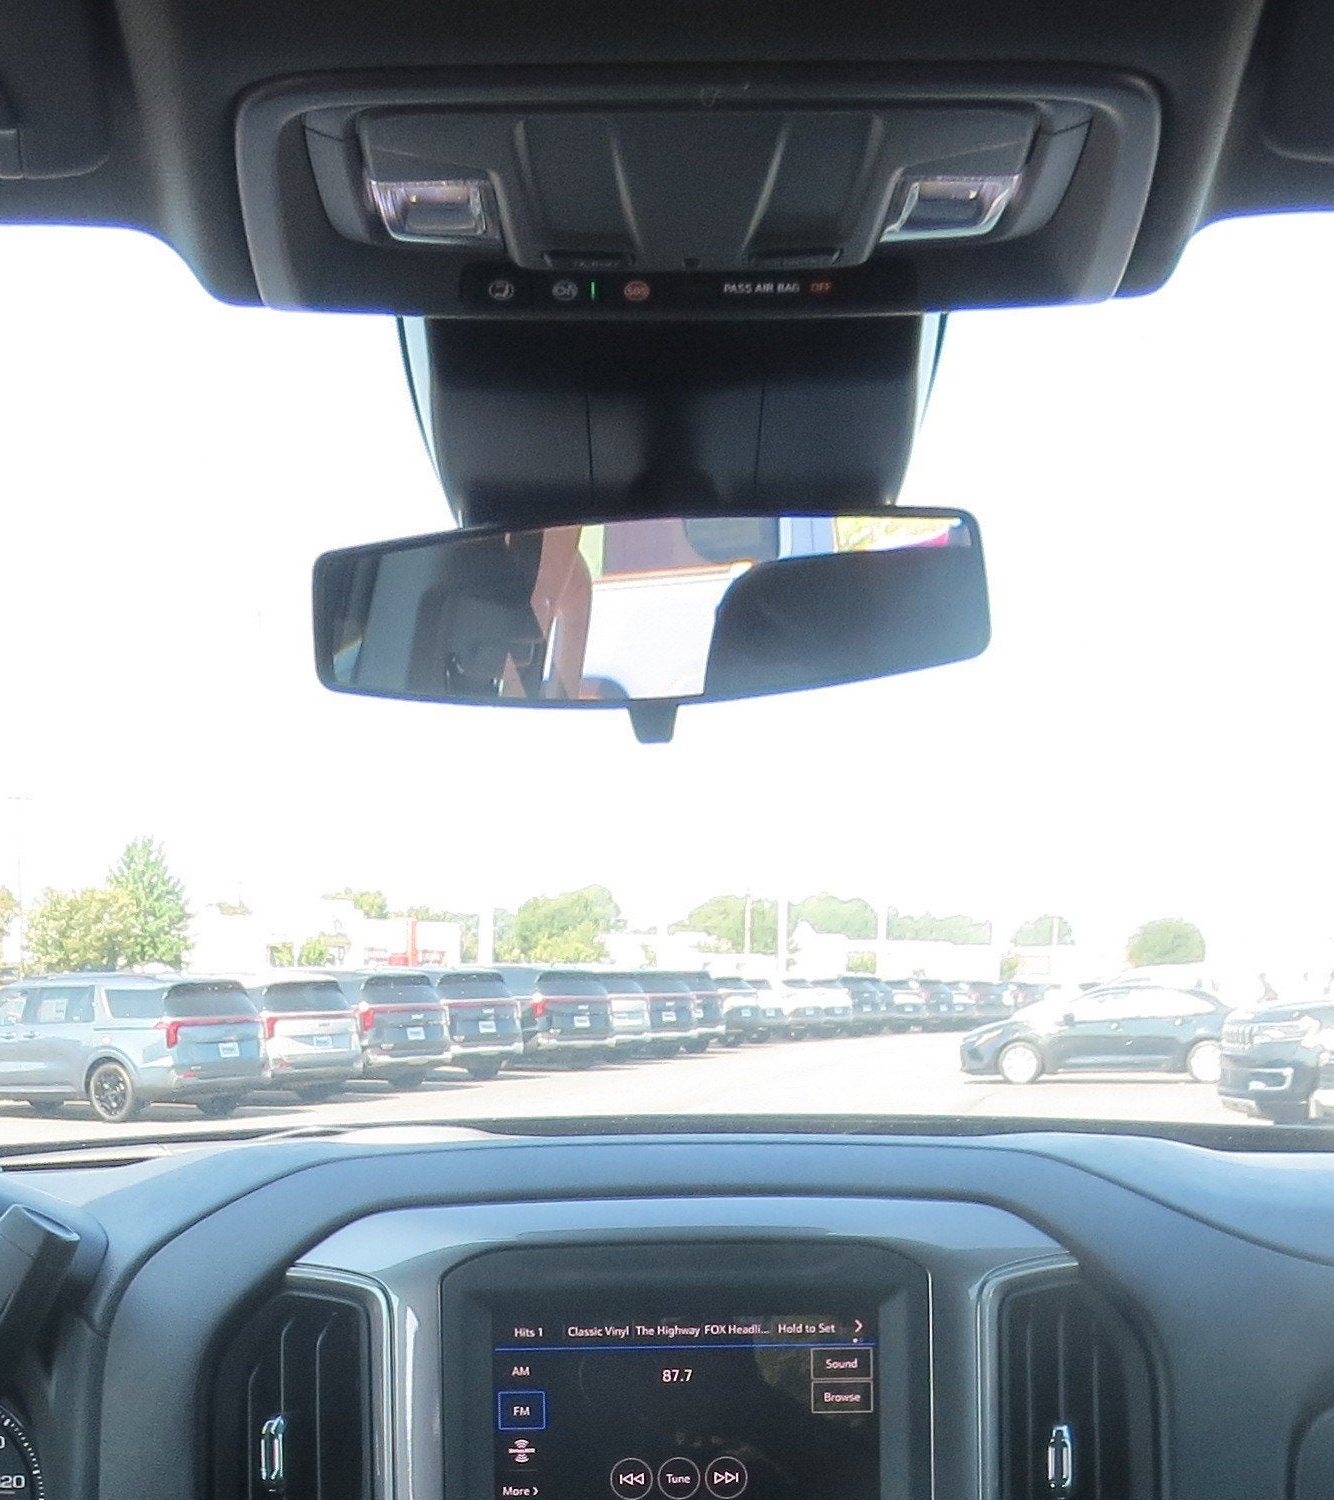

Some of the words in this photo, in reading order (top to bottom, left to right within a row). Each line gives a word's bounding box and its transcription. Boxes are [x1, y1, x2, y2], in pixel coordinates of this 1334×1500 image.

[723, 282, 753, 294] PASS
[754, 282, 774, 293] AIR
[776, 282, 801, 293] BAG
[810, 282, 832, 293] OFF
[514, 1327, 535, 1338] Hits
[538, 1327, 544, 1337] 1
[567, 1326, 602, 1337] Classic
[604, 1325, 630, 1338] Vinyl
[635, 1325, 655, 1336] The
[657, 1324, 701, 1338] Highway
[704, 1324, 727, 1335] FOX
[778, 1323, 803, 1334] Hold
[805, 1324, 816, 1334] to
[818, 1323, 836, 1334] Set
[825, 1358, 858, 1369] Sound
[511, 1366, 530, 1377] AM
[661, 1368, 693, 1382] 87.7
[823, 1392, 861, 1403] Browse
[513, 1406, 530, 1416] FM
[665, 1473, 691, 1484] Tune
[502, 1486, 531, 1497] More
